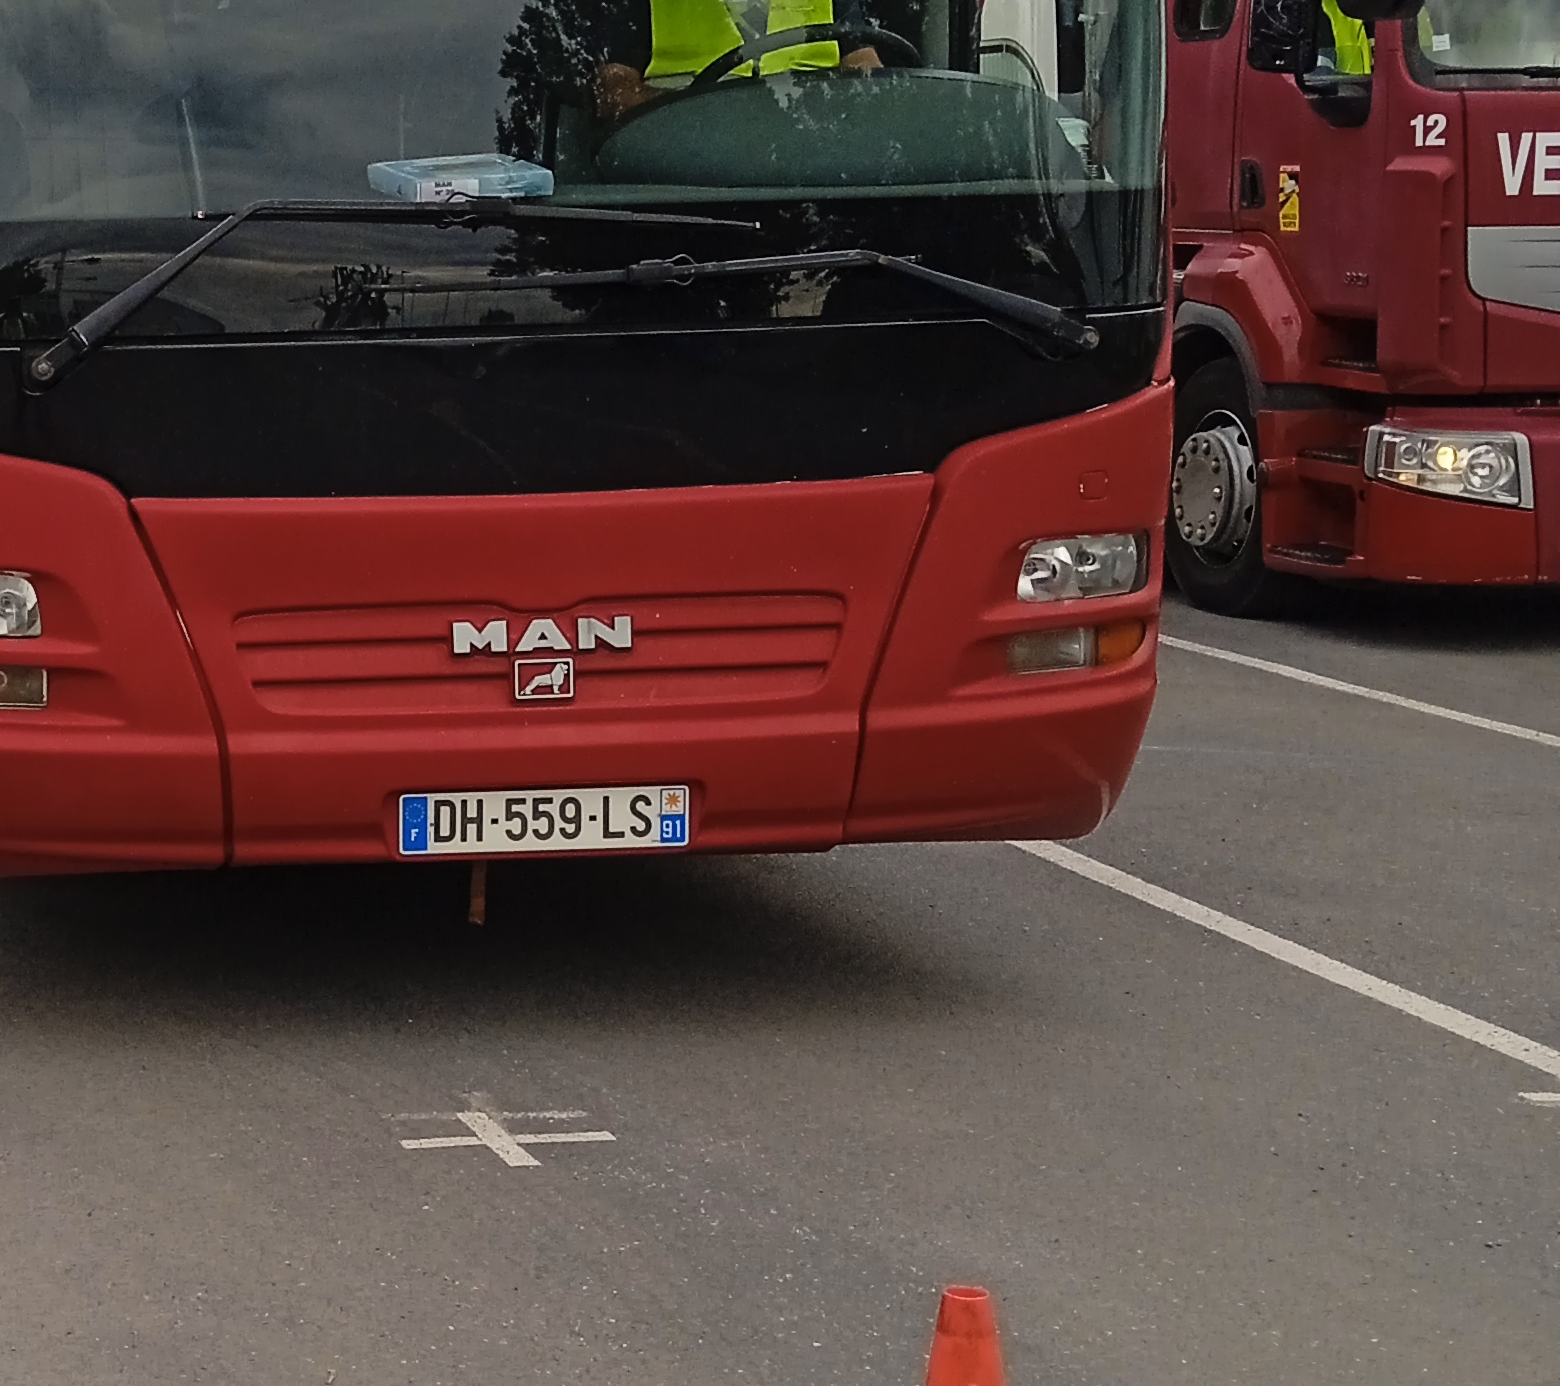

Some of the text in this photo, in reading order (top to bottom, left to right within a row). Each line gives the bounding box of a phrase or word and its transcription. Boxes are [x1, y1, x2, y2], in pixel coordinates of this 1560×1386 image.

[1410, 114, 1447, 147] 12
[1497, 132, 1560, 196] VE
[453, 616, 632, 654] MAN
[410, 794, 681, 844] F DH-559-LS 91
